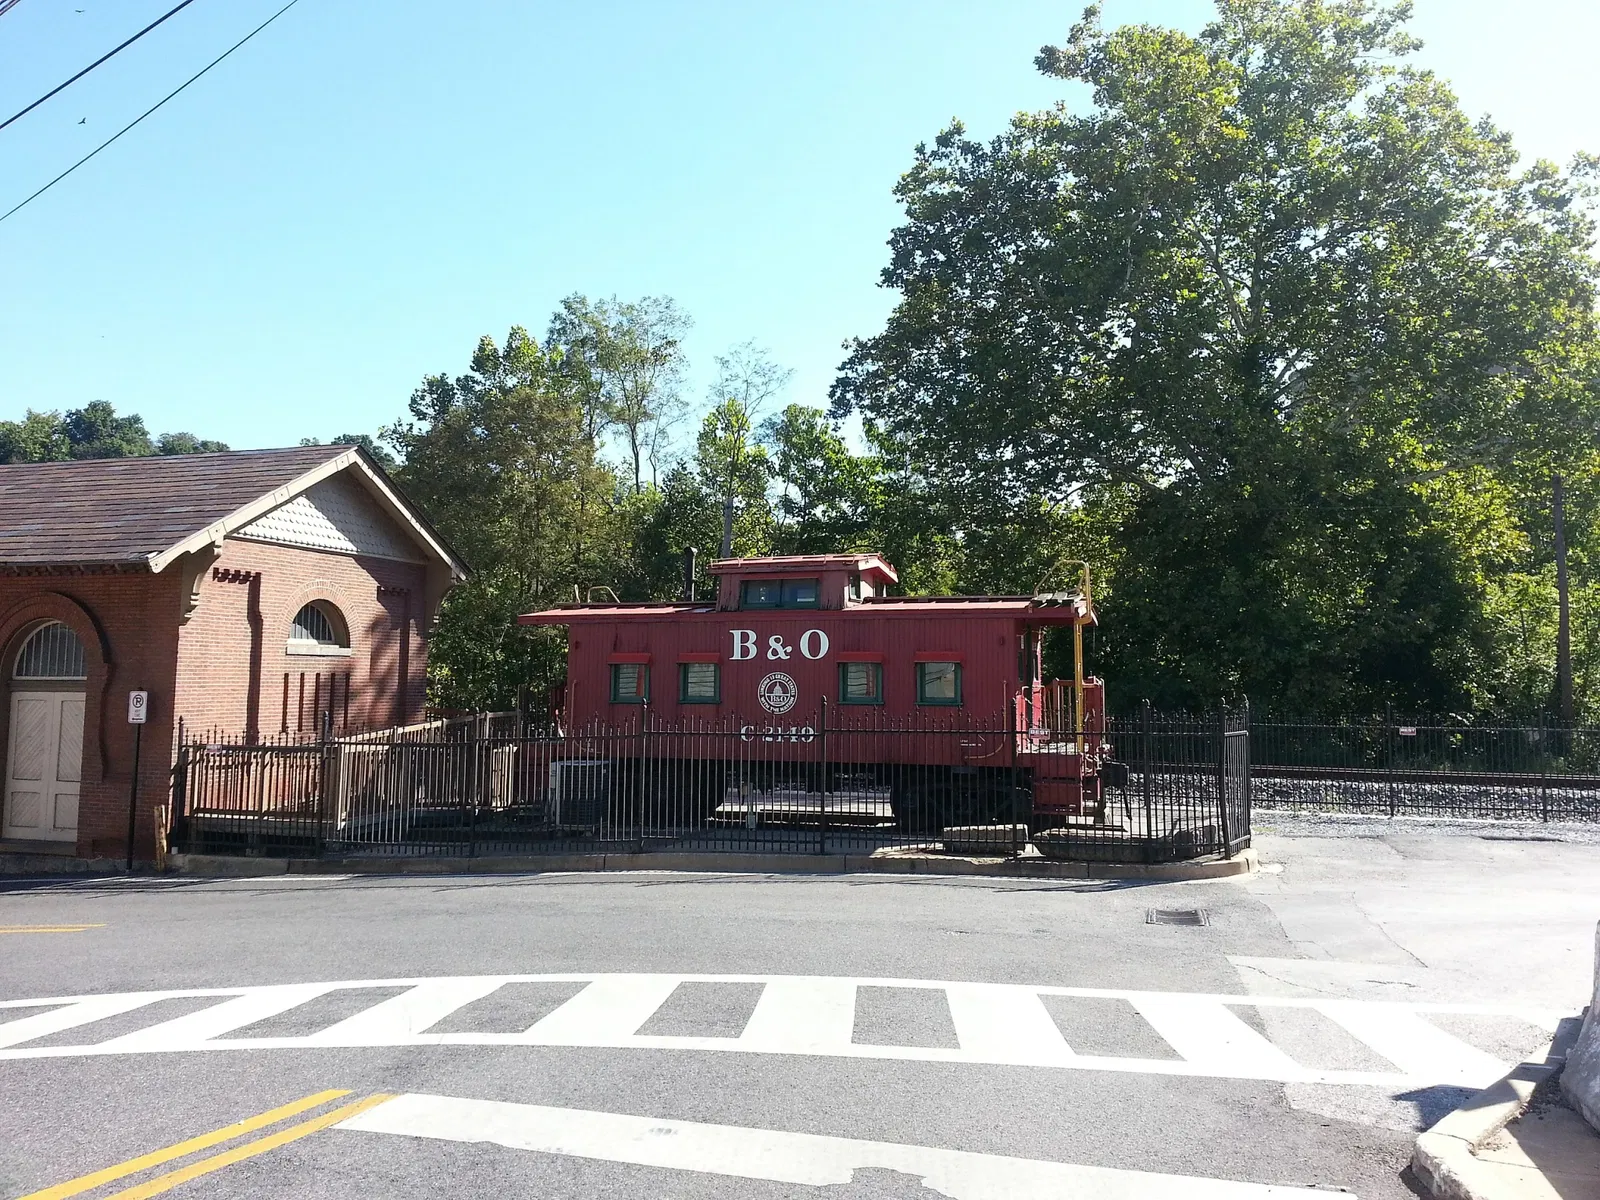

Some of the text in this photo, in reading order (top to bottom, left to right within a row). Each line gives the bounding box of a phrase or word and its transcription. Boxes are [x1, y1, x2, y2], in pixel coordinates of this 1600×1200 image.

[729, 629, 829, 660] B & O
